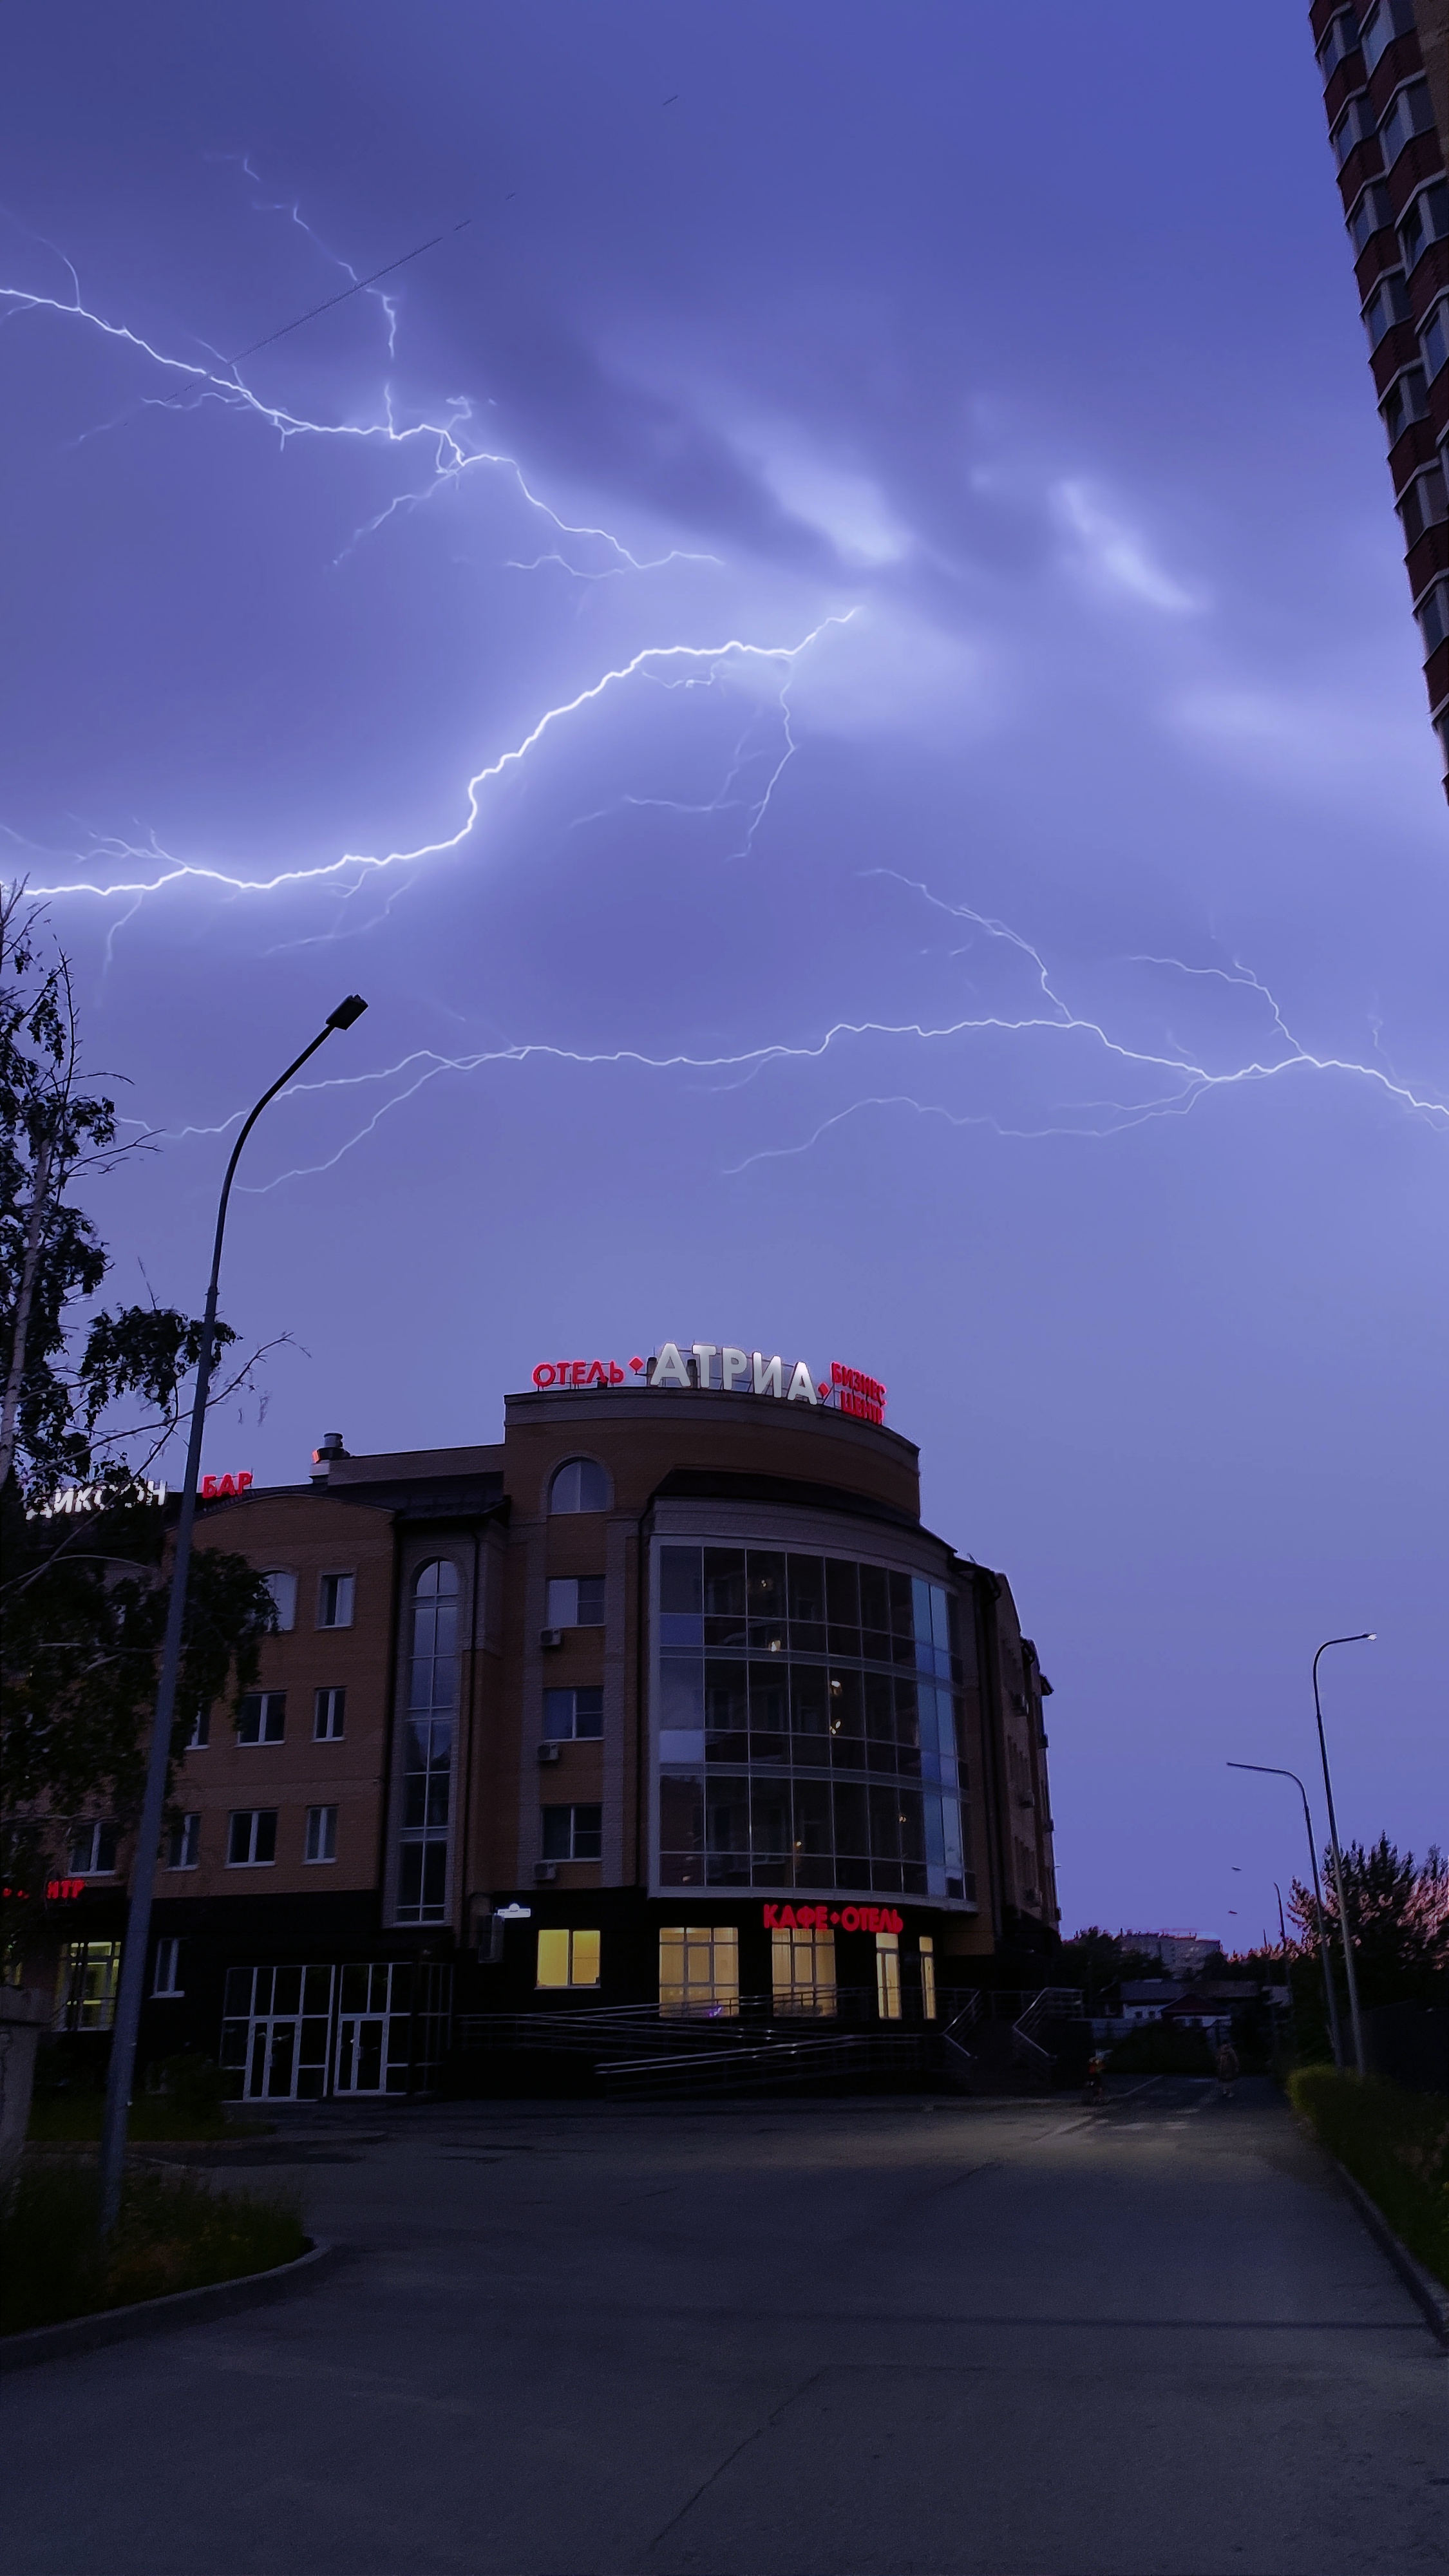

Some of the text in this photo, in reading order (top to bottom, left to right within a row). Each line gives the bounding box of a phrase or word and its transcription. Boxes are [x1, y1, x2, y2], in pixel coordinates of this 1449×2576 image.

[533, 1343, 817, 1405] ОТЕЛЬ АТРИА
[831, 1361, 886, 1406] БИЗНЕС
[840, 1390, 884, 1425] ЦЕНТР
[203, 1472, 252, 1498] БАР
[764, 1904, 903, 1933] КАФЕ ОТЕЛЬ
